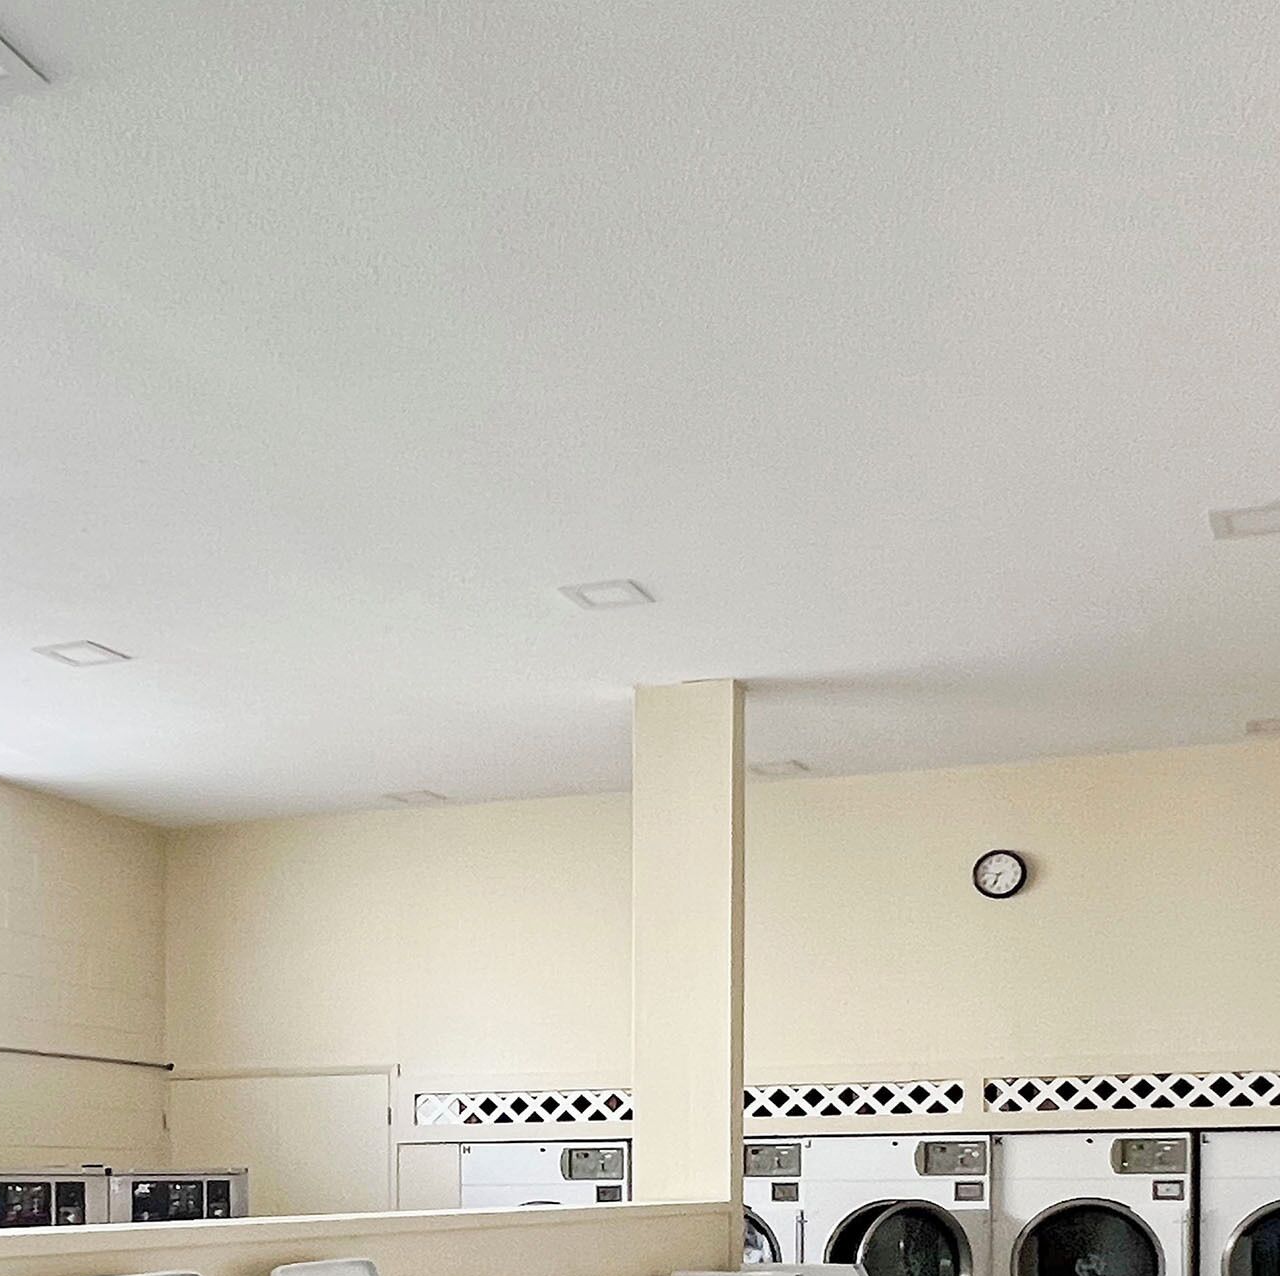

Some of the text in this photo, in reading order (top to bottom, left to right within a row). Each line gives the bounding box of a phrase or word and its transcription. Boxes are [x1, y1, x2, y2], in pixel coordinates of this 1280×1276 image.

[994, 1136, 1003, 1145] K
[1202, 1133, 1210, 1144] L
[804, 1140, 812, 1149] J
[463, 1146, 471, 1154] H
